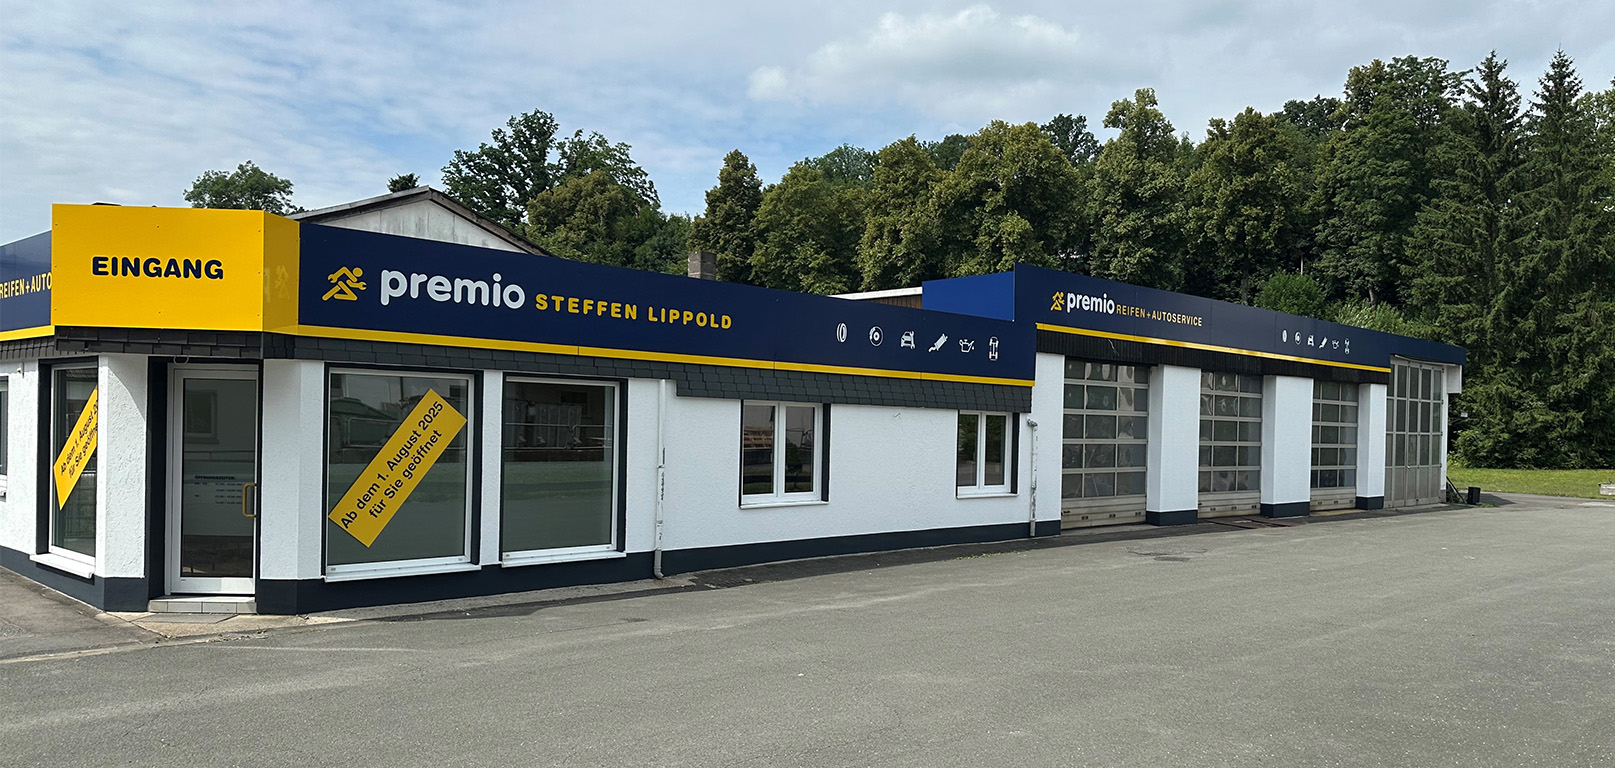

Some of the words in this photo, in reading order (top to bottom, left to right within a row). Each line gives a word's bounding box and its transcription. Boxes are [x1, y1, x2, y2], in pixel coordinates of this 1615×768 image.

[92, 256, 224, 280] EINGANG
[380, 268, 525, 310] premio
[535, 293, 638, 320] STEFFEN
[648, 306, 732, 330] LIPPOLD
[1066, 292, 1115, 314] premio
[340, 510, 358, 529] Ab
[356, 483, 380, 510] dem
[377, 473, 389, 482] 1.
[386, 429, 422, 472] August
[418, 401, 443, 431] 2025
[368, 499, 387, 519] für
[384, 479, 404, 499] Sie
[402, 429, 443, 480] geöffnet
